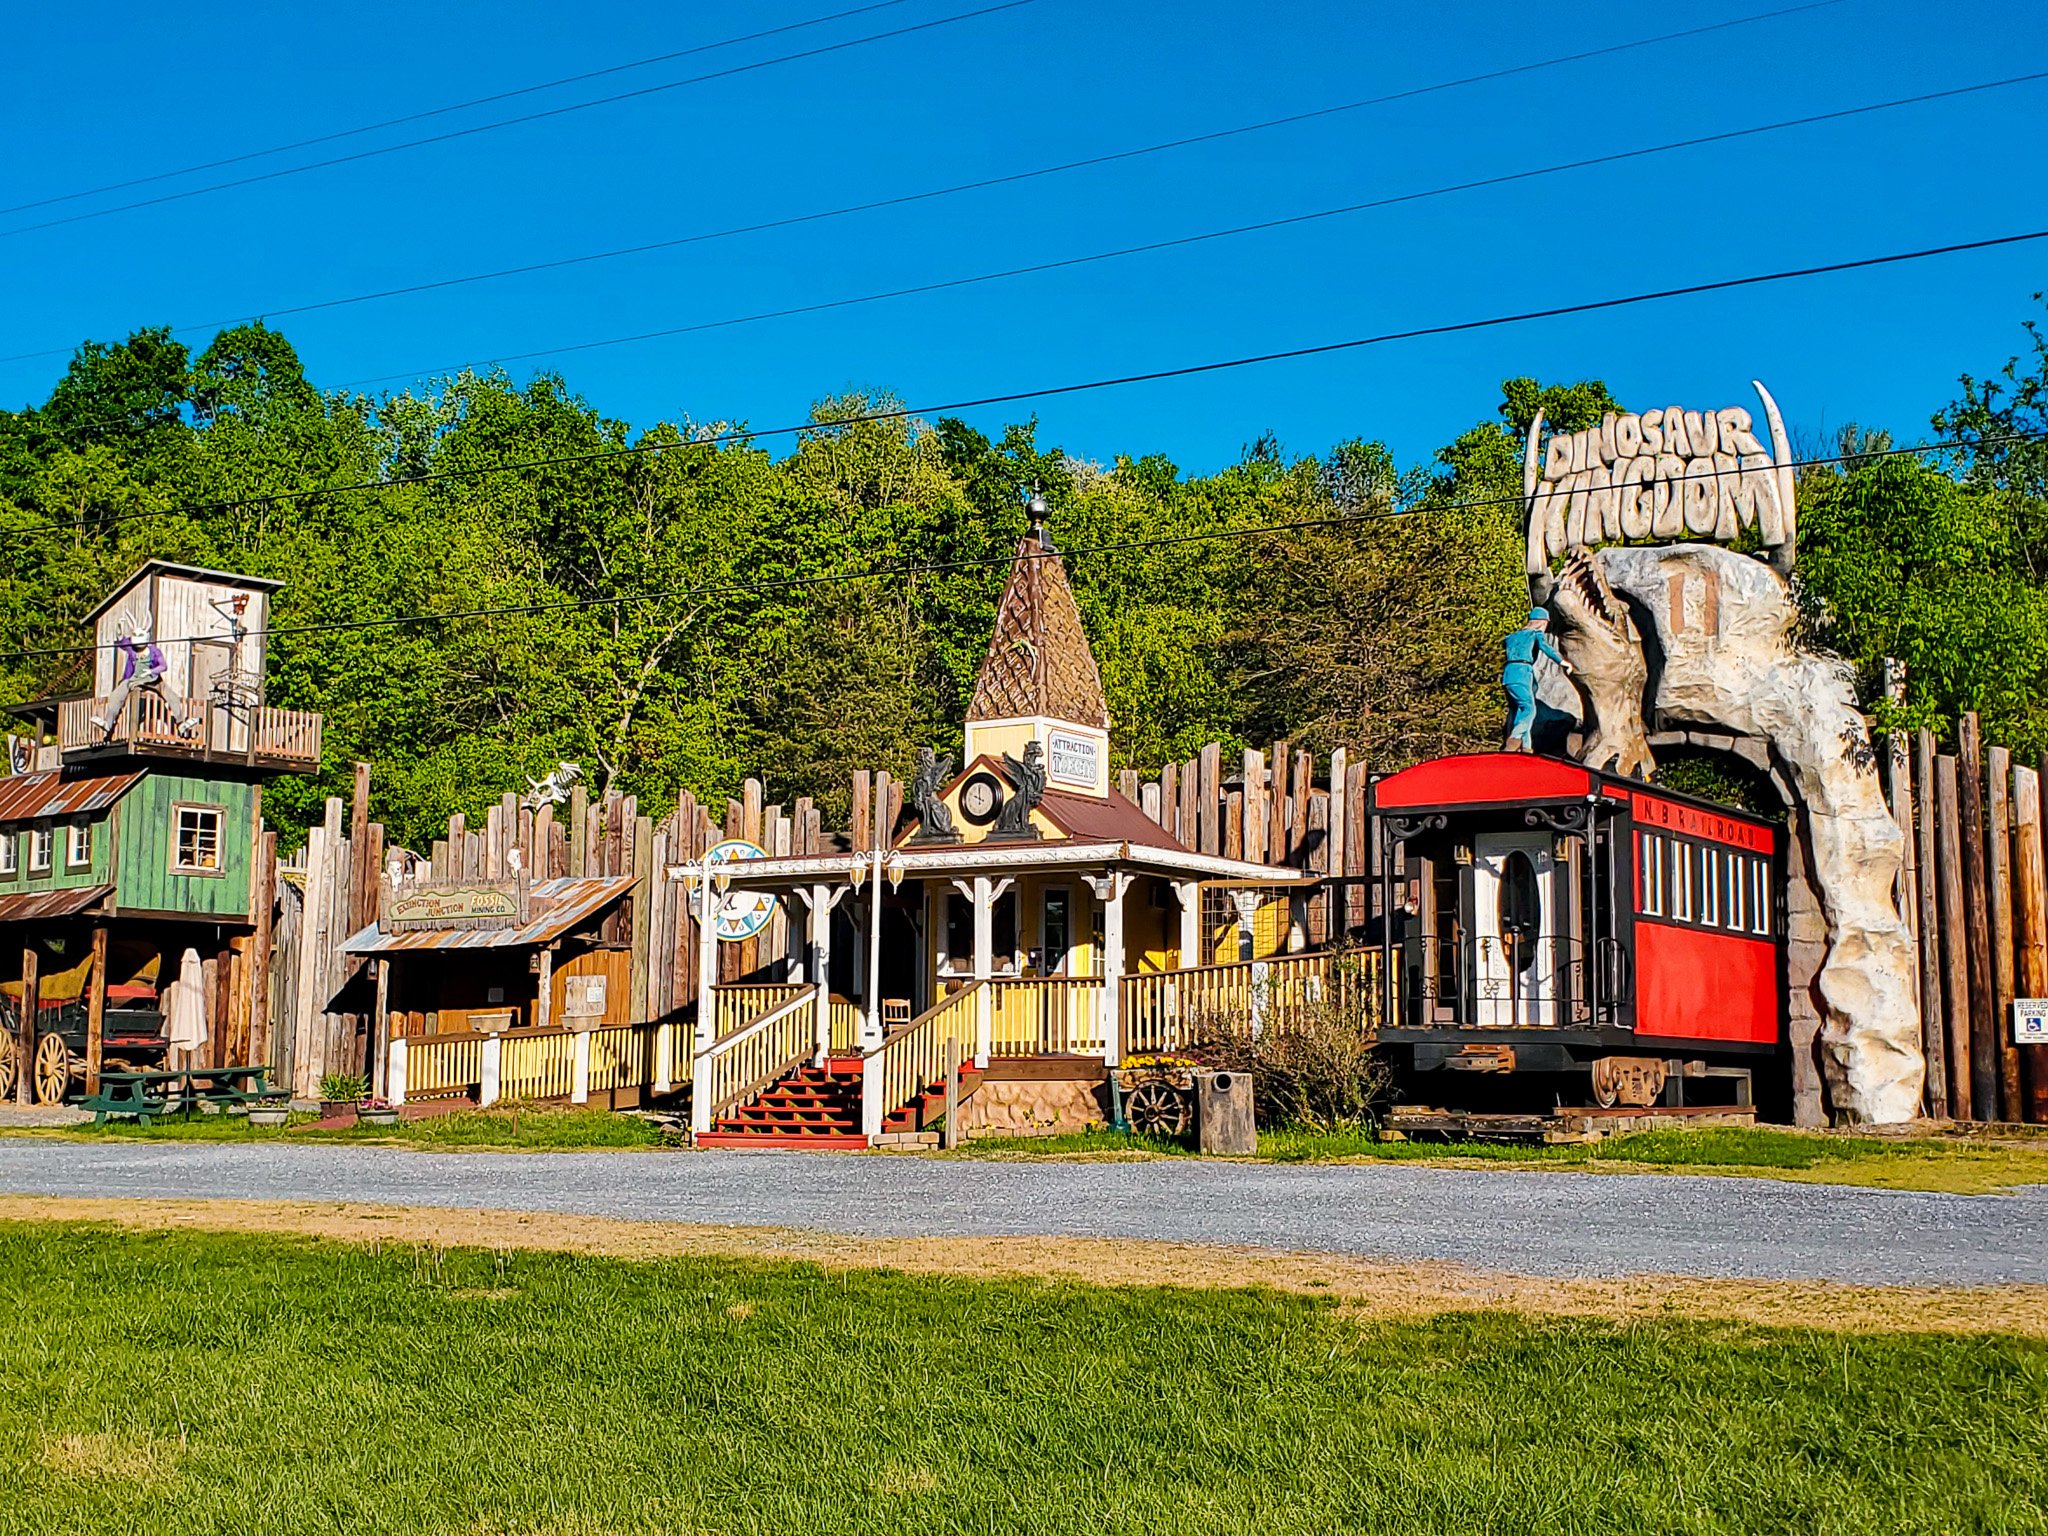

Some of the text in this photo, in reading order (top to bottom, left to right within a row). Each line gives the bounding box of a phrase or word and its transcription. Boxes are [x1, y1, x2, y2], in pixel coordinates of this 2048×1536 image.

[1544, 406, 1767, 481] DINOSAUR
[1527, 453, 1785, 574] KINGDOM
[1679, 809, 1754, 847] RAILROAD
[426, 903, 463, 917] JUNCTION
[470, 895, 504, 906] FOSSIL
[471, 906, 495, 914] MINING
